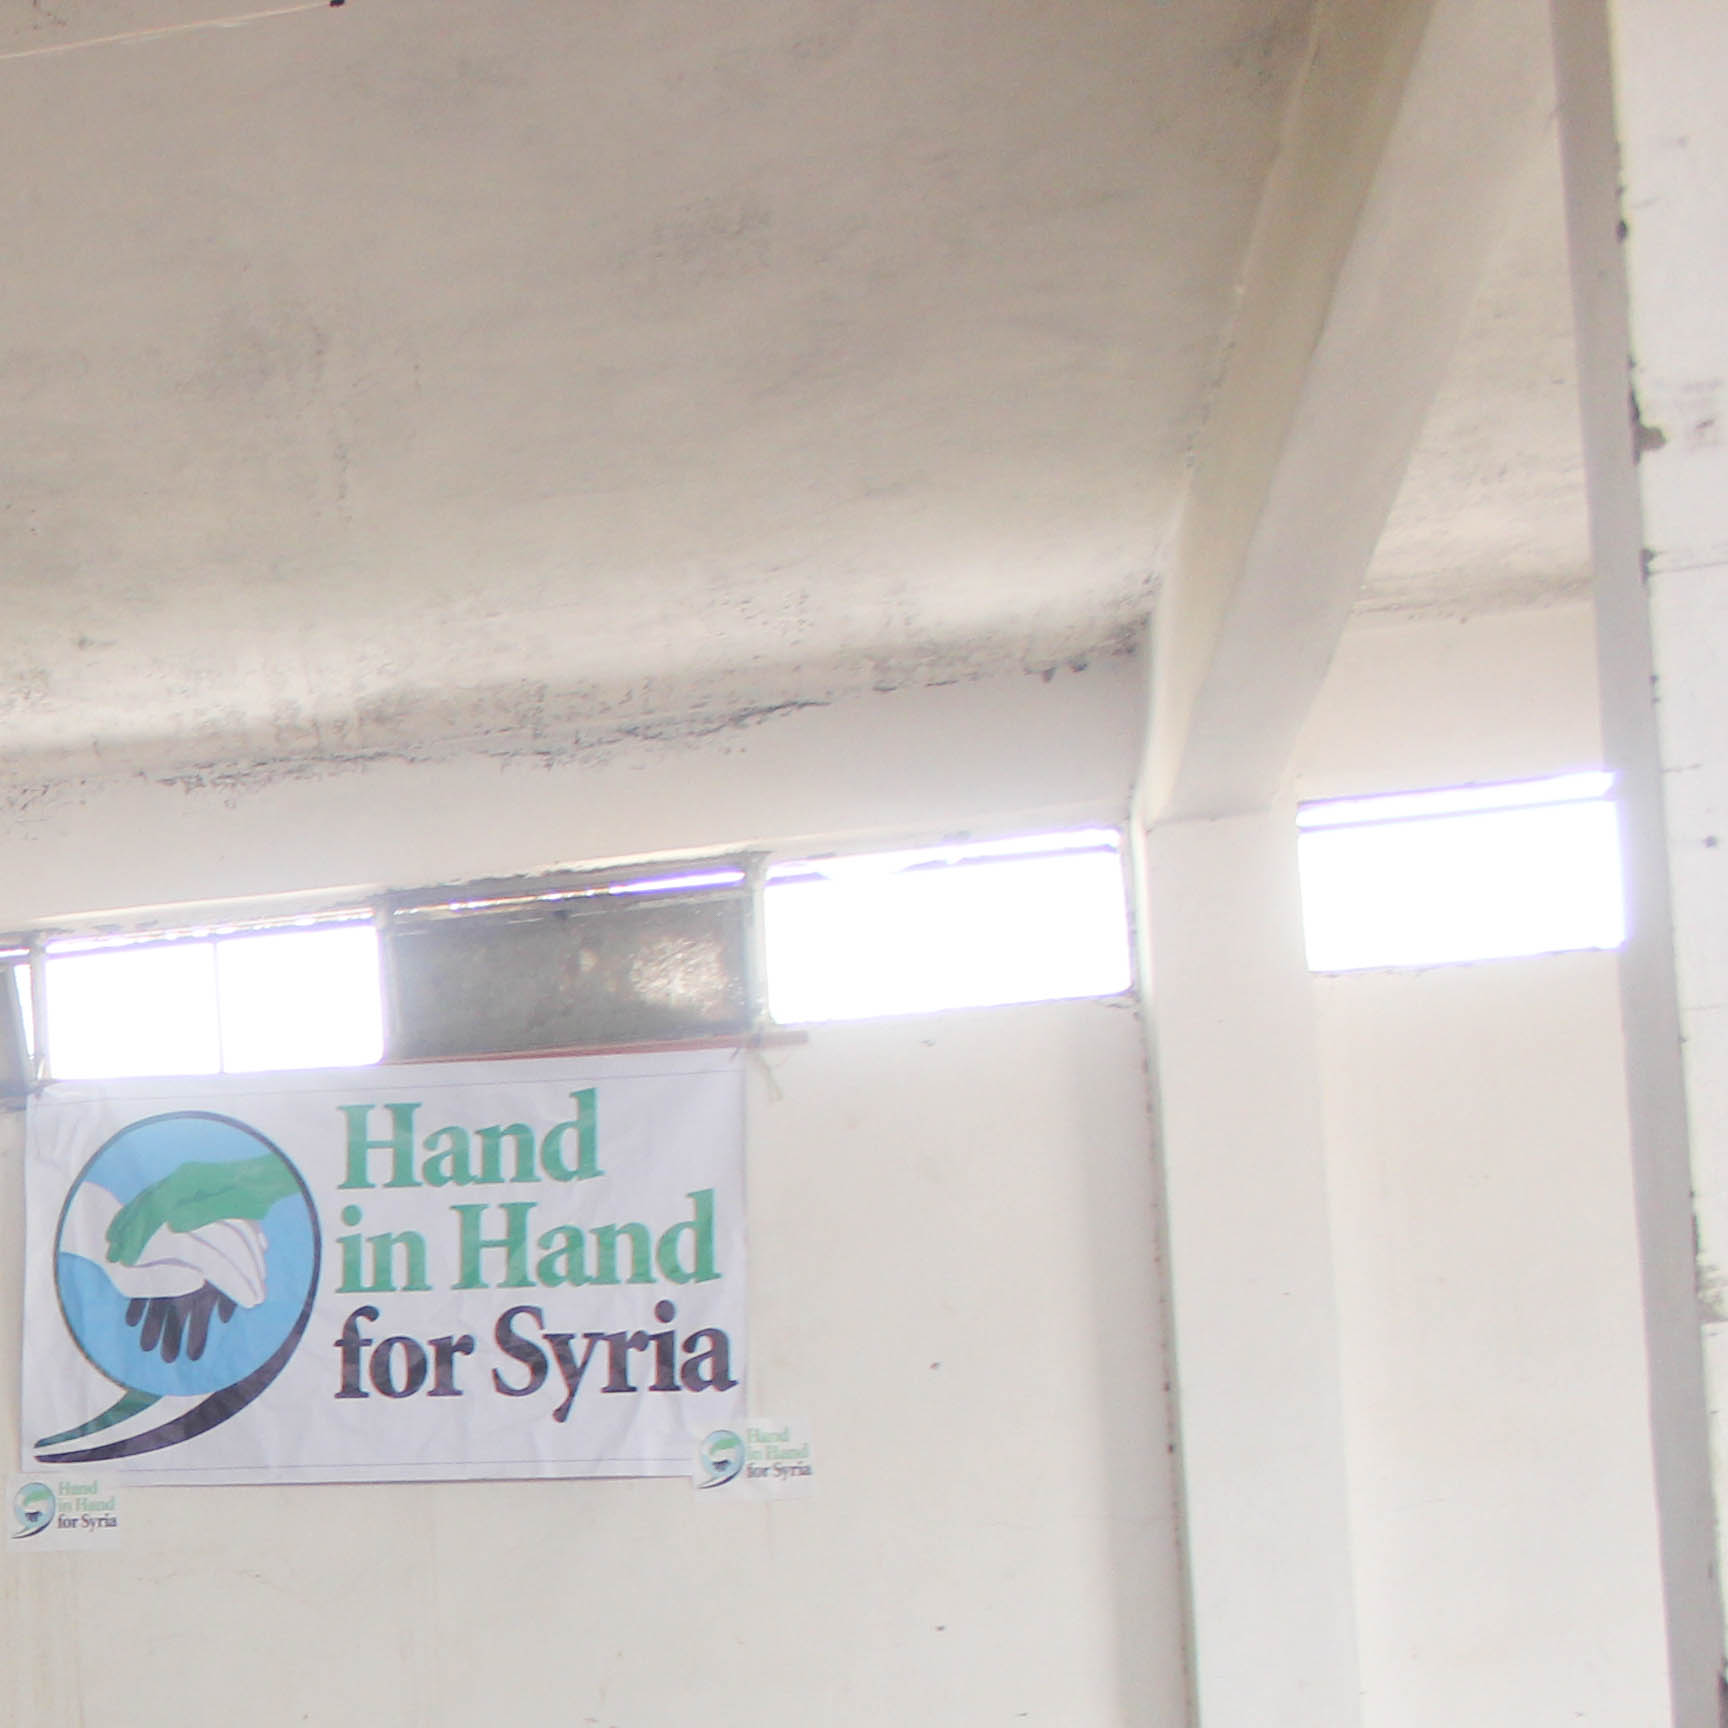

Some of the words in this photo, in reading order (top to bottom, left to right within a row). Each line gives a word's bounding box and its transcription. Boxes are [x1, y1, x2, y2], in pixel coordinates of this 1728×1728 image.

[336, 1087, 606, 1190] Hand
[335, 1204, 433, 1294] in
[449, 1188, 723, 1290] Hand
[333, 1305, 476, 1399] for
[490, 1299, 738, 1424] Syria
[57, 1513, 78, 1529] for
[80, 1512, 117, 1532] Syria
[747, 1462, 770, 1478] for
[773, 1460, 812, 1481] Syria
